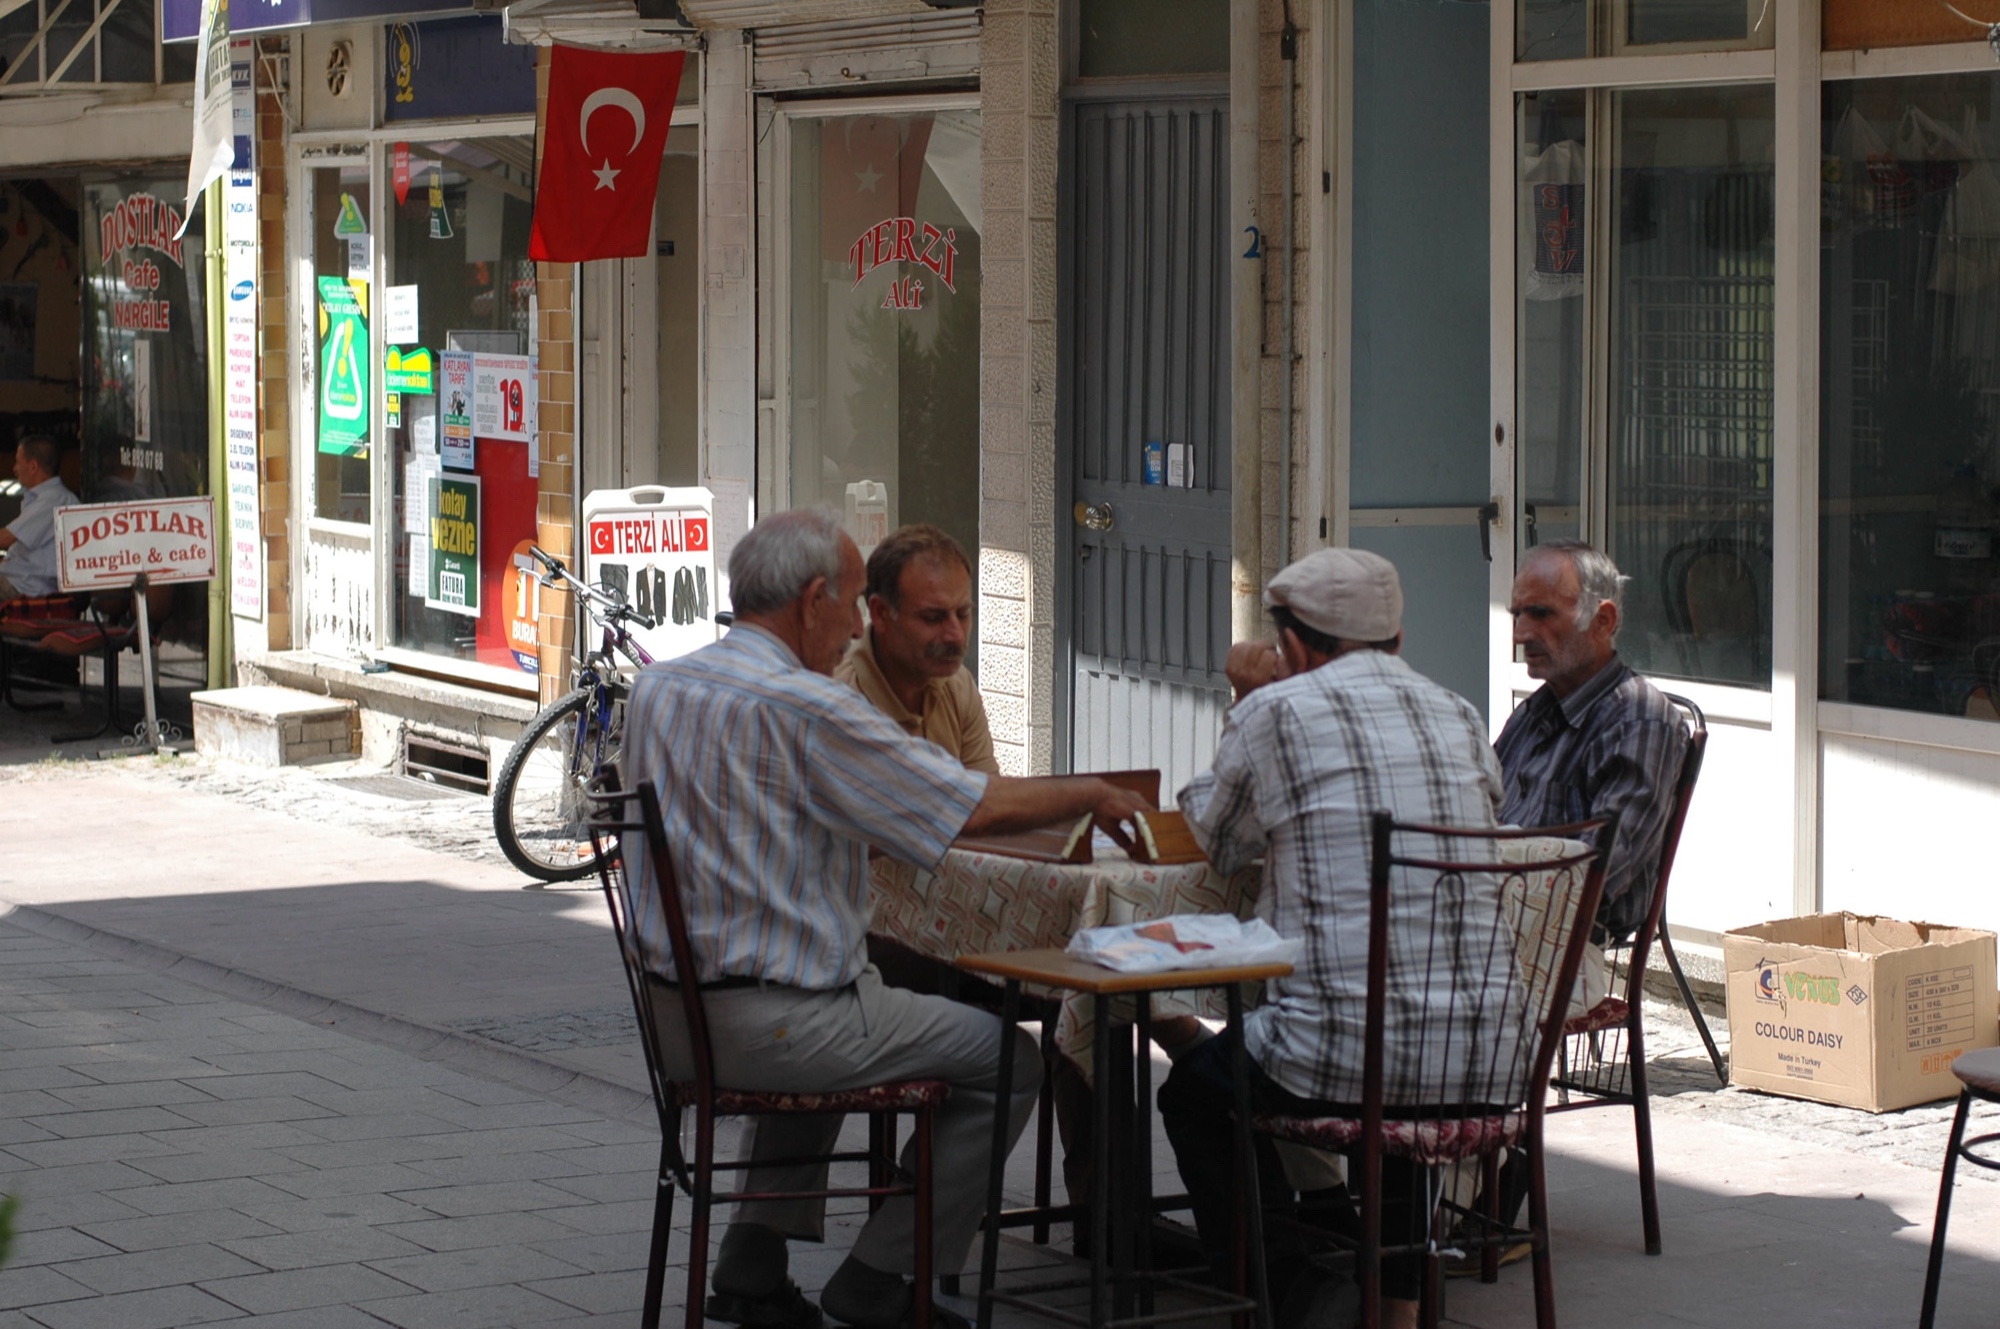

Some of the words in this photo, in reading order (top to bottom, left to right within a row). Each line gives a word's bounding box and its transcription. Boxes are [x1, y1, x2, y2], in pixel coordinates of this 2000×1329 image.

[231, 203, 253, 213] NOKIA
[101, 192, 183, 269] DOSTLAR
[1243, 225, 1261, 259] 2
[123, 258, 160, 291] Cafe
[880, 275, 924, 310] Ali
[114, 291, 170, 332] NARGİLE
[230, 394, 252, 404] TELEFON
[500, 378, 524, 433] 19
[439, 486, 467, 520] kolay
[70, 510, 208, 551] DOSTLAR
[431, 517, 476, 556] vezne
[615, 511, 657, 555] TERZİ
[661, 510, 683, 553] ALİ
[75, 549, 141, 571] nargile
[148, 547, 163, 563] &
[169, 544, 207, 563] cafe
[442, 575, 463, 594] FATURA
[512, 619, 539, 645] BURA
[1784, 971, 1841, 1006] VENUS
[1907, 978, 1922, 986] CODE
[1907, 990, 1919, 998] SIZE
[1755, 1022, 1804, 1043] COLOUR
[1808, 1030, 1843, 1049] DAISY
[1908, 1028, 1920, 1036] UNIT
[1933, 1024, 1948, 1032] UNITS
[1777, 1052, 1794, 1062] Made
[1795, 1055, 1801, 1063] in
[1801, 1056, 1821, 1069] Turkey
